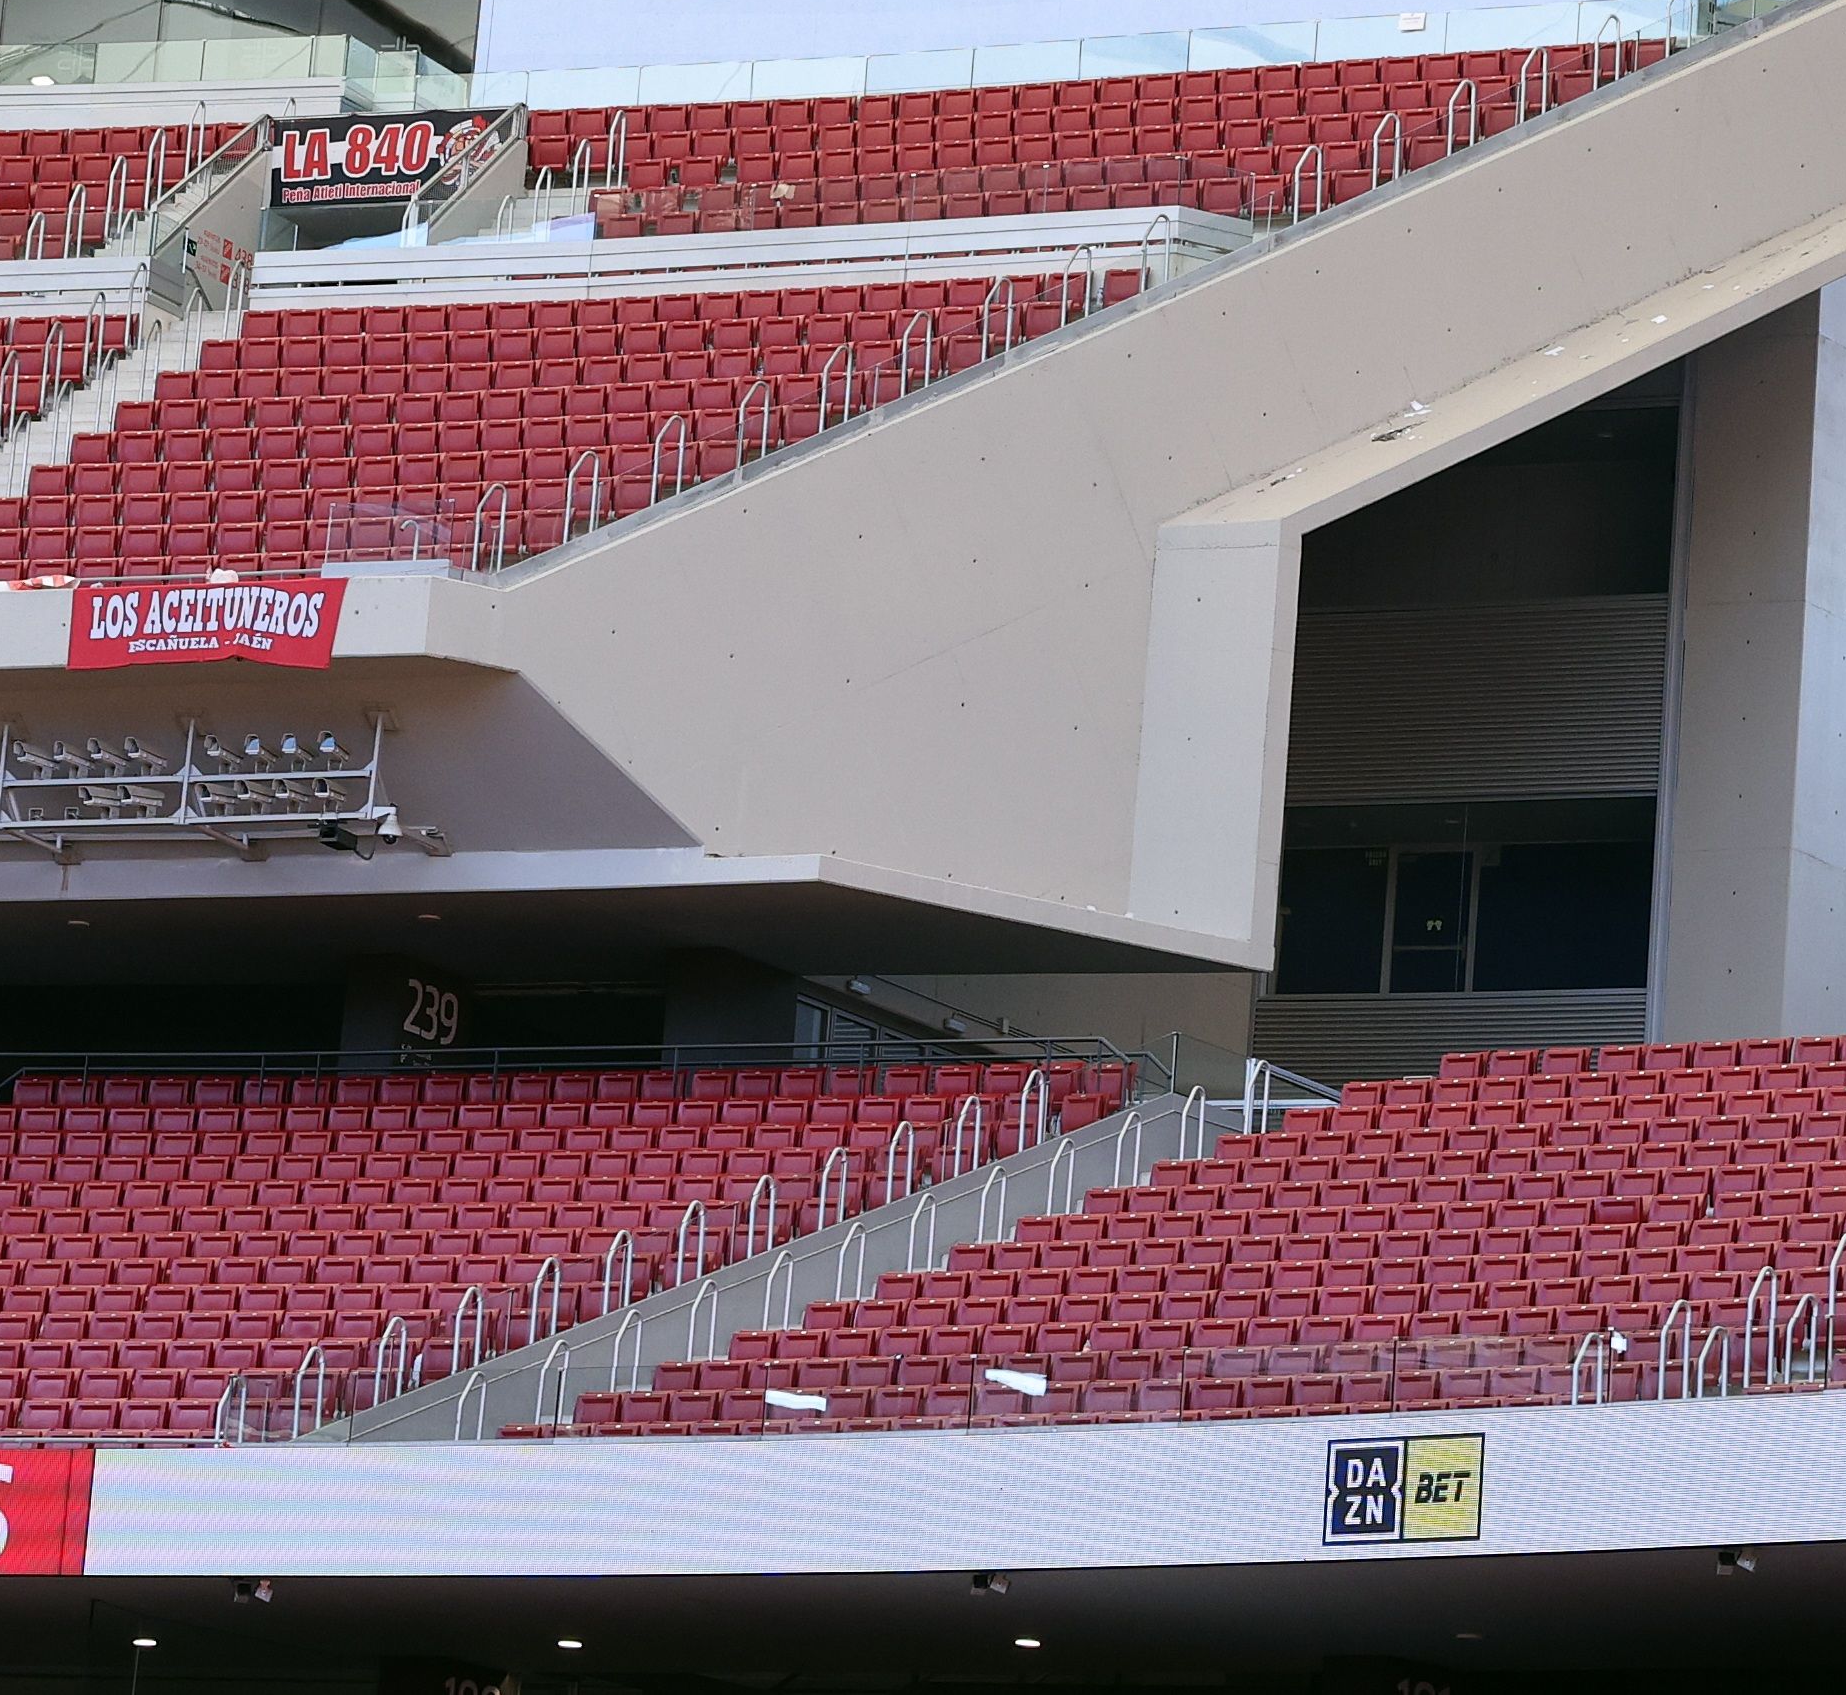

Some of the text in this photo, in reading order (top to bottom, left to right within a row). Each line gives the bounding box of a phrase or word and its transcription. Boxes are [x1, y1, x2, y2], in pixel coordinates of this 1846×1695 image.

[281, 120, 436, 183] LA 840
[281, 181, 421, 203] Peña Atleti Internacional
[89, 586, 325, 640] LOS ACEITUNEROS
[403, 978, 459, 1045] 239
[1415, 1470, 1471, 1505] BET
